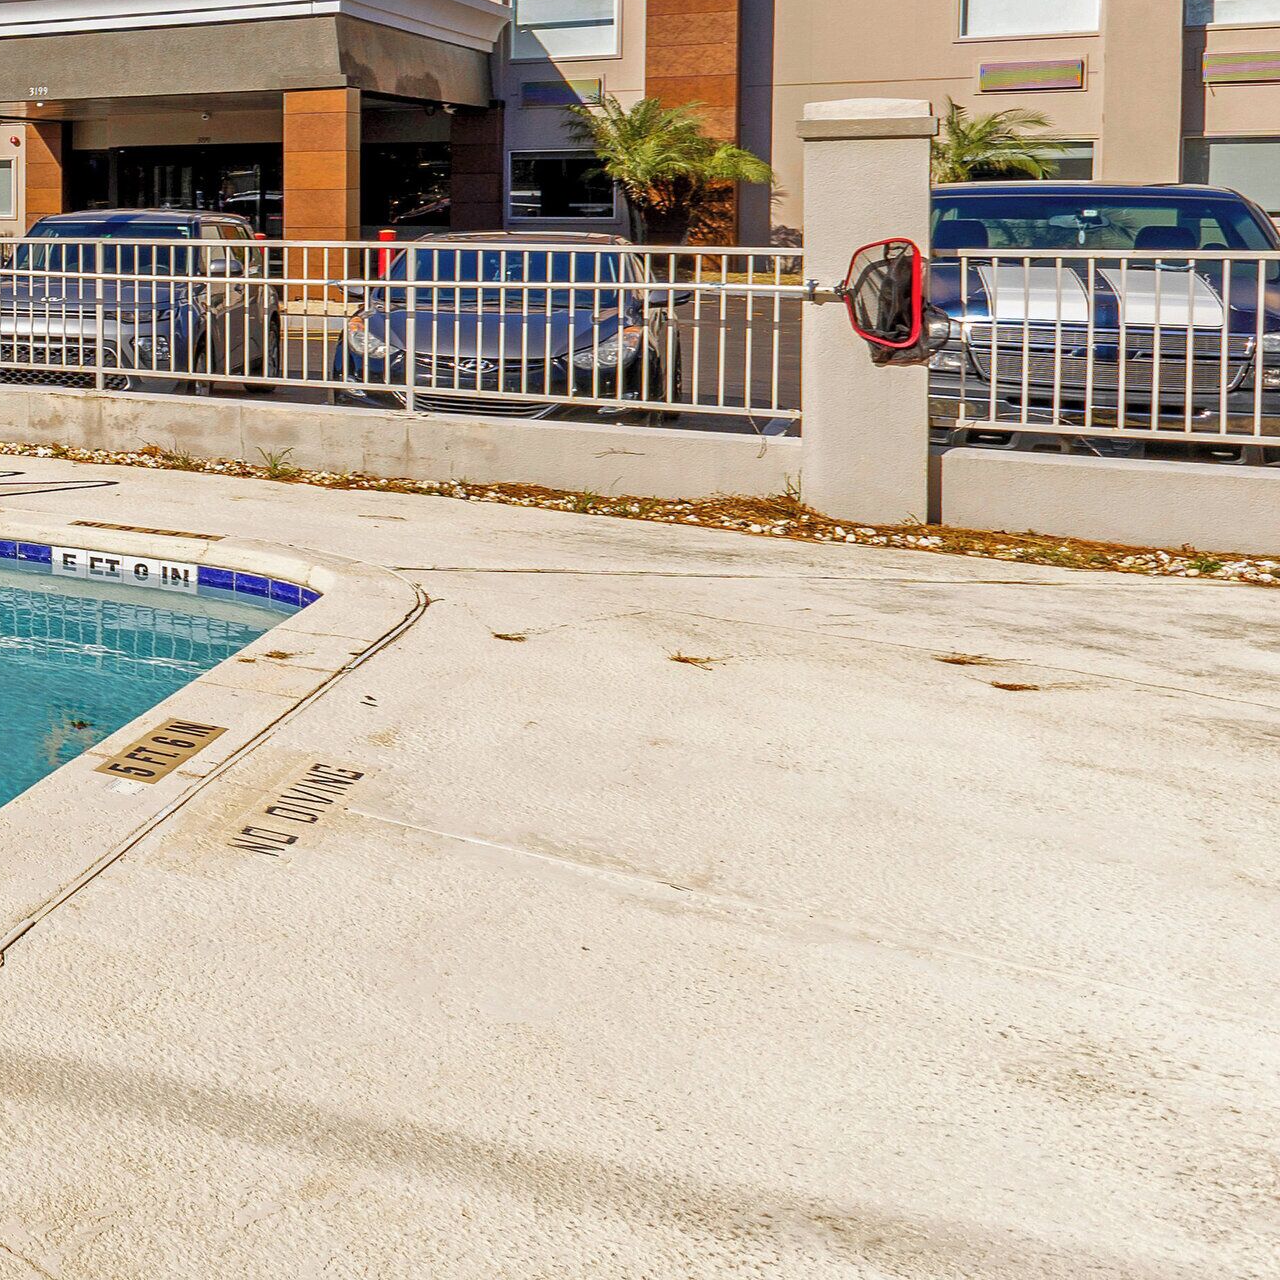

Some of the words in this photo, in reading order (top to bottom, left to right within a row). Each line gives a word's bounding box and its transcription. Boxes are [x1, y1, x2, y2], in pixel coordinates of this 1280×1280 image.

[28, 86, 49, 97] 3199
[107, 762, 156, 778] 5
[151, 736, 196, 749] 6
[227, 825, 299, 857] NO
[264, 763, 365, 824] DIVING
